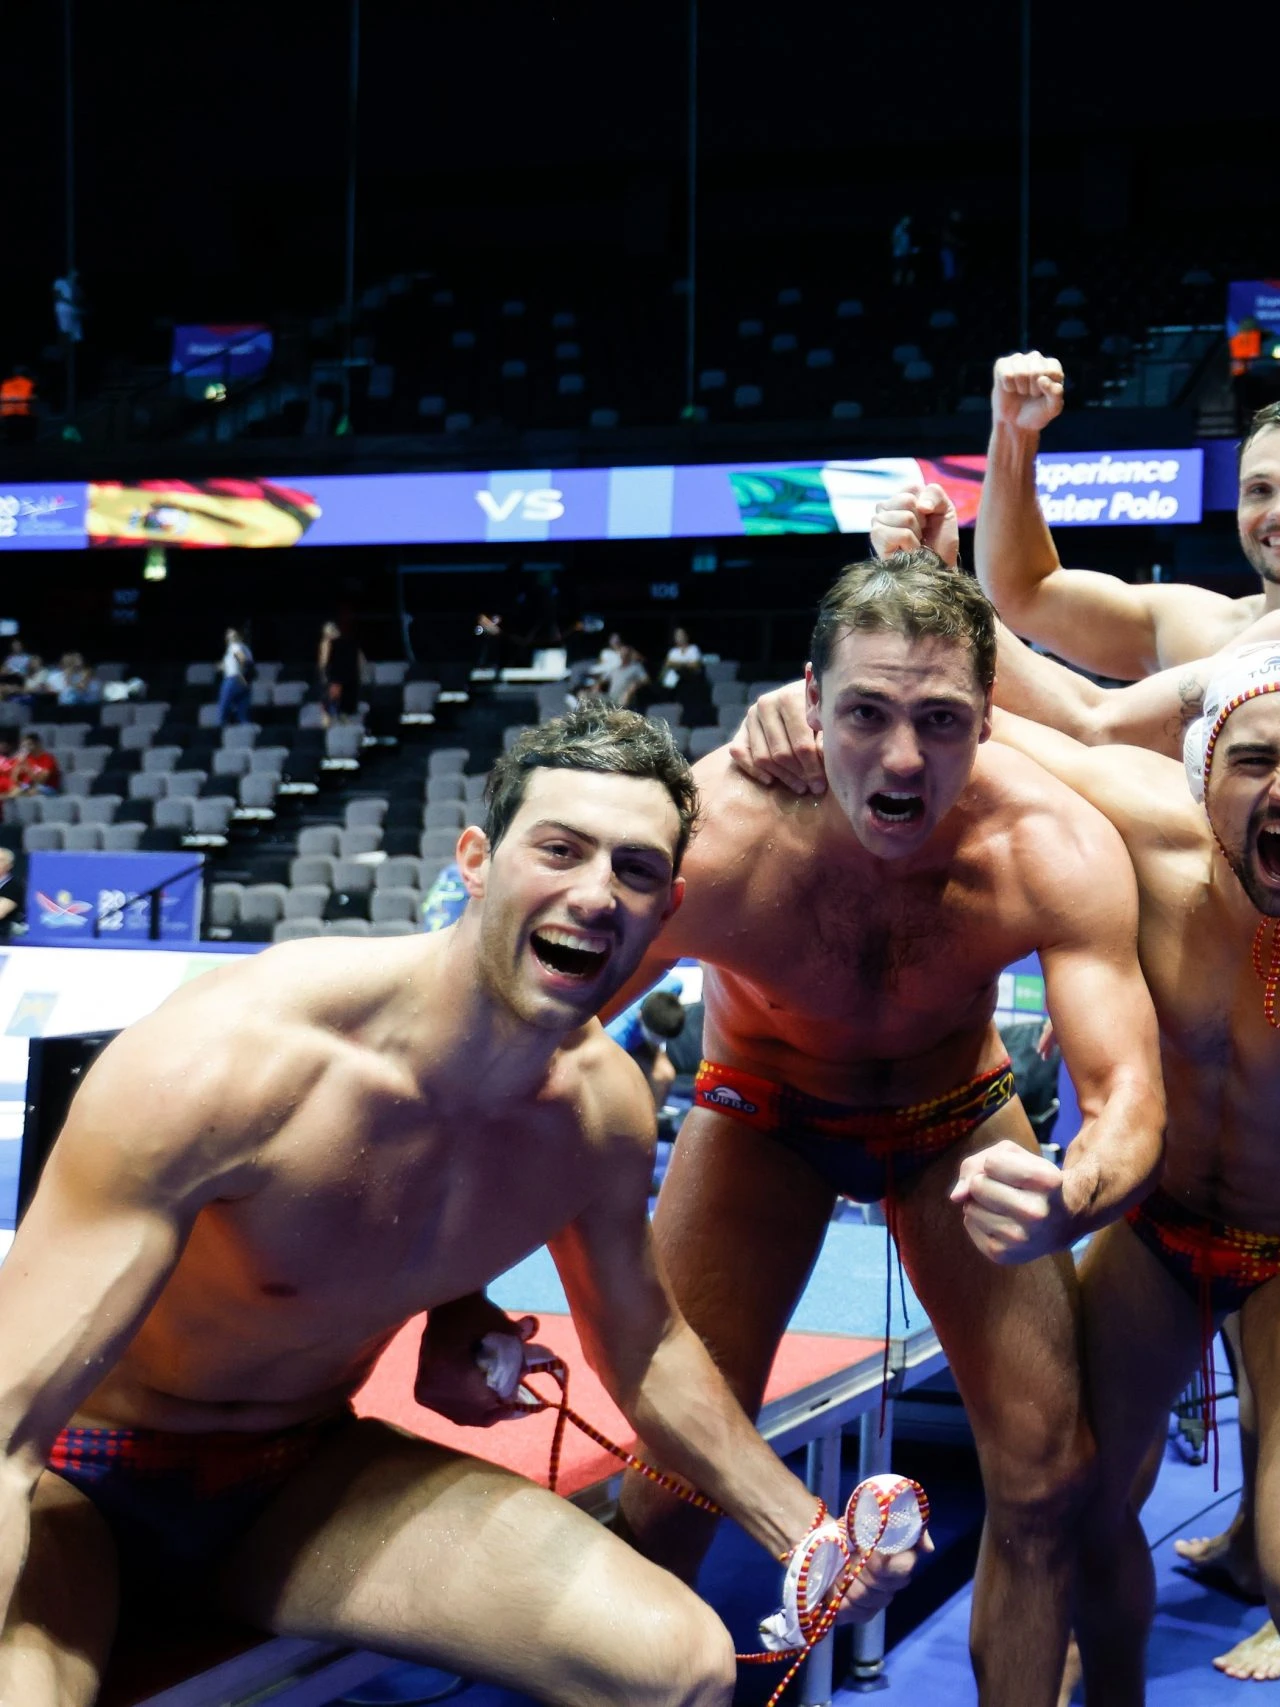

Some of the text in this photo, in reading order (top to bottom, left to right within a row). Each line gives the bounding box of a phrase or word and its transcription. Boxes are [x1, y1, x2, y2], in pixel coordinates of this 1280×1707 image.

[1035, 455, 1180, 492] xperience
[475, 487, 565, 523] VS
[1108, 490, 1179, 521] Polo
[703, 1090, 757, 1113] TURBO
